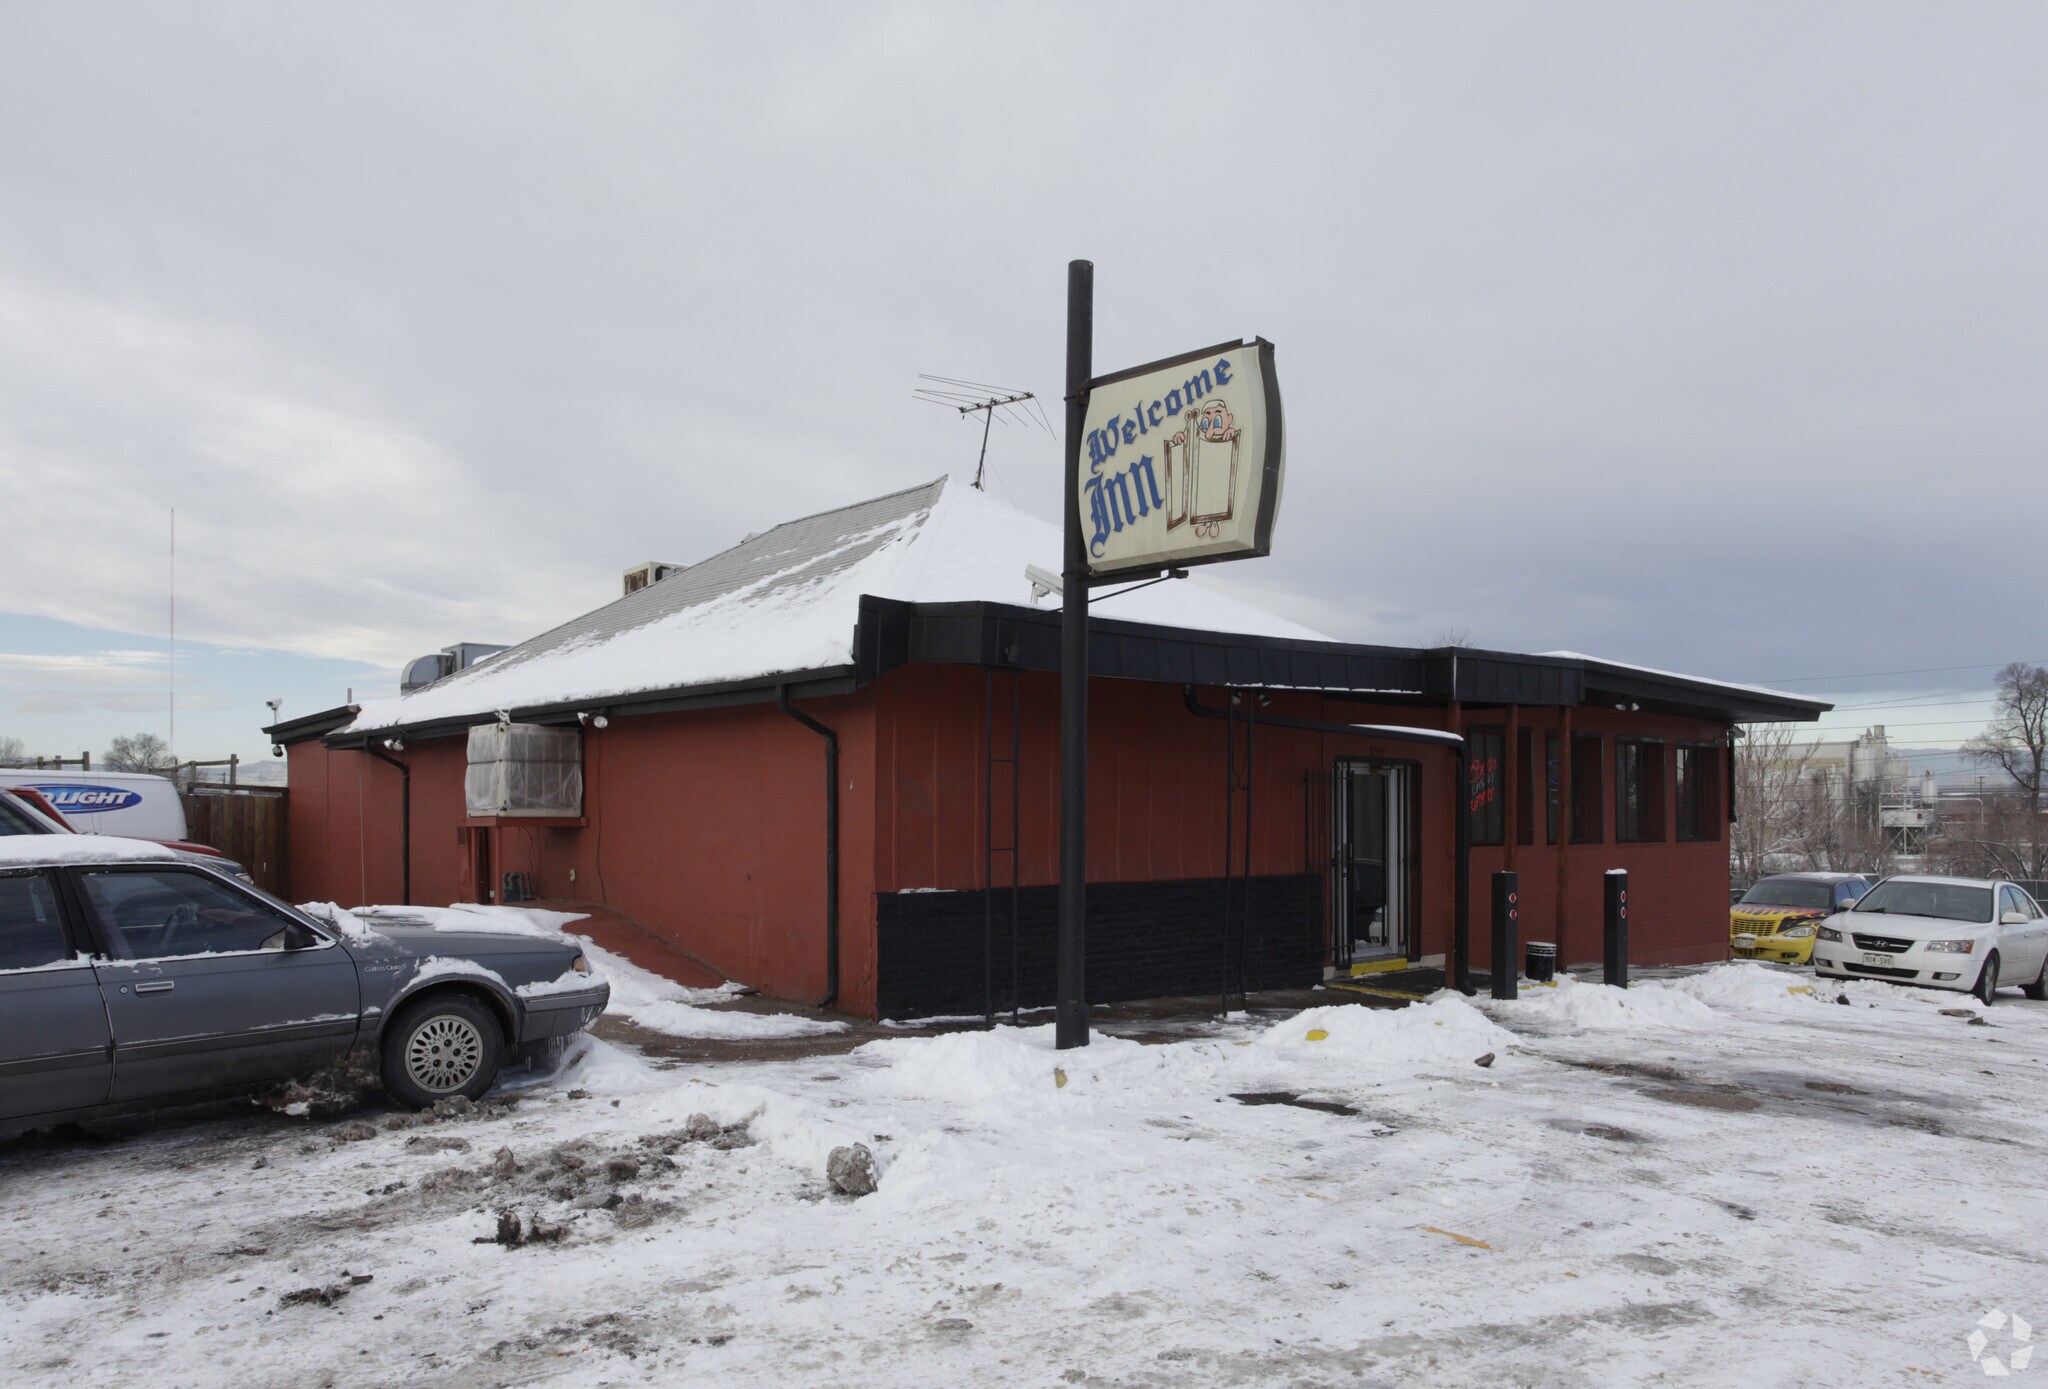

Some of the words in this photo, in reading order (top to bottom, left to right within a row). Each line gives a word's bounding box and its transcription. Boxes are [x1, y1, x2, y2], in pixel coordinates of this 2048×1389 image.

[1086, 358, 1233, 475] Welcome
[1084, 454, 1164, 558] Inn
[56, 792, 132, 805] LIGHT
